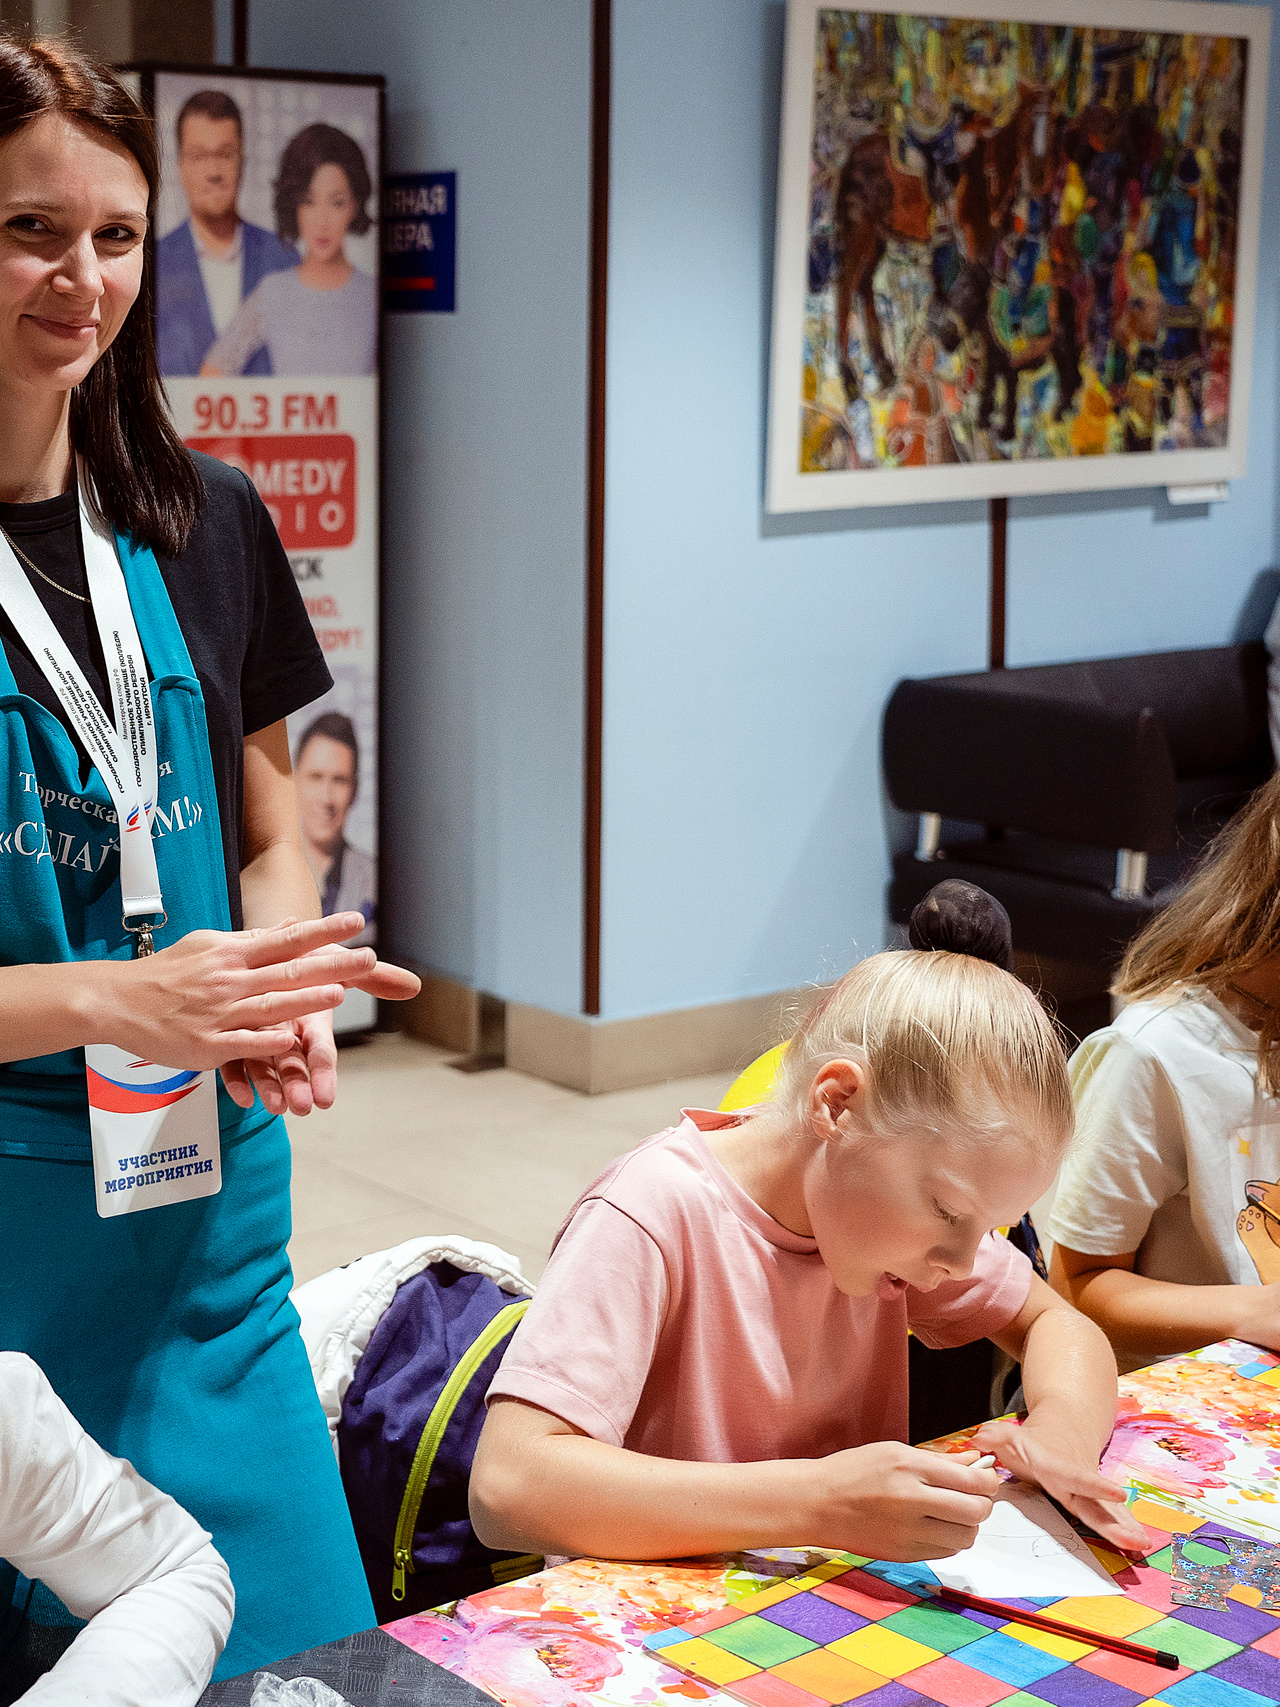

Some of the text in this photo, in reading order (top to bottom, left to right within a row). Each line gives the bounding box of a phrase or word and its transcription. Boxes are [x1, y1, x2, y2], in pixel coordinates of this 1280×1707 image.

[194, 393, 337, 430] 90.3 FM
[232, 457, 348, 497] MEDY
[84, 689, 109, 729] ИРКУТСКА
[126, 654, 147, 756] ОЛИМПИЙСКОГО РЕЗЕРВА
[139, 676, 151, 719] ИРКУТСКА
